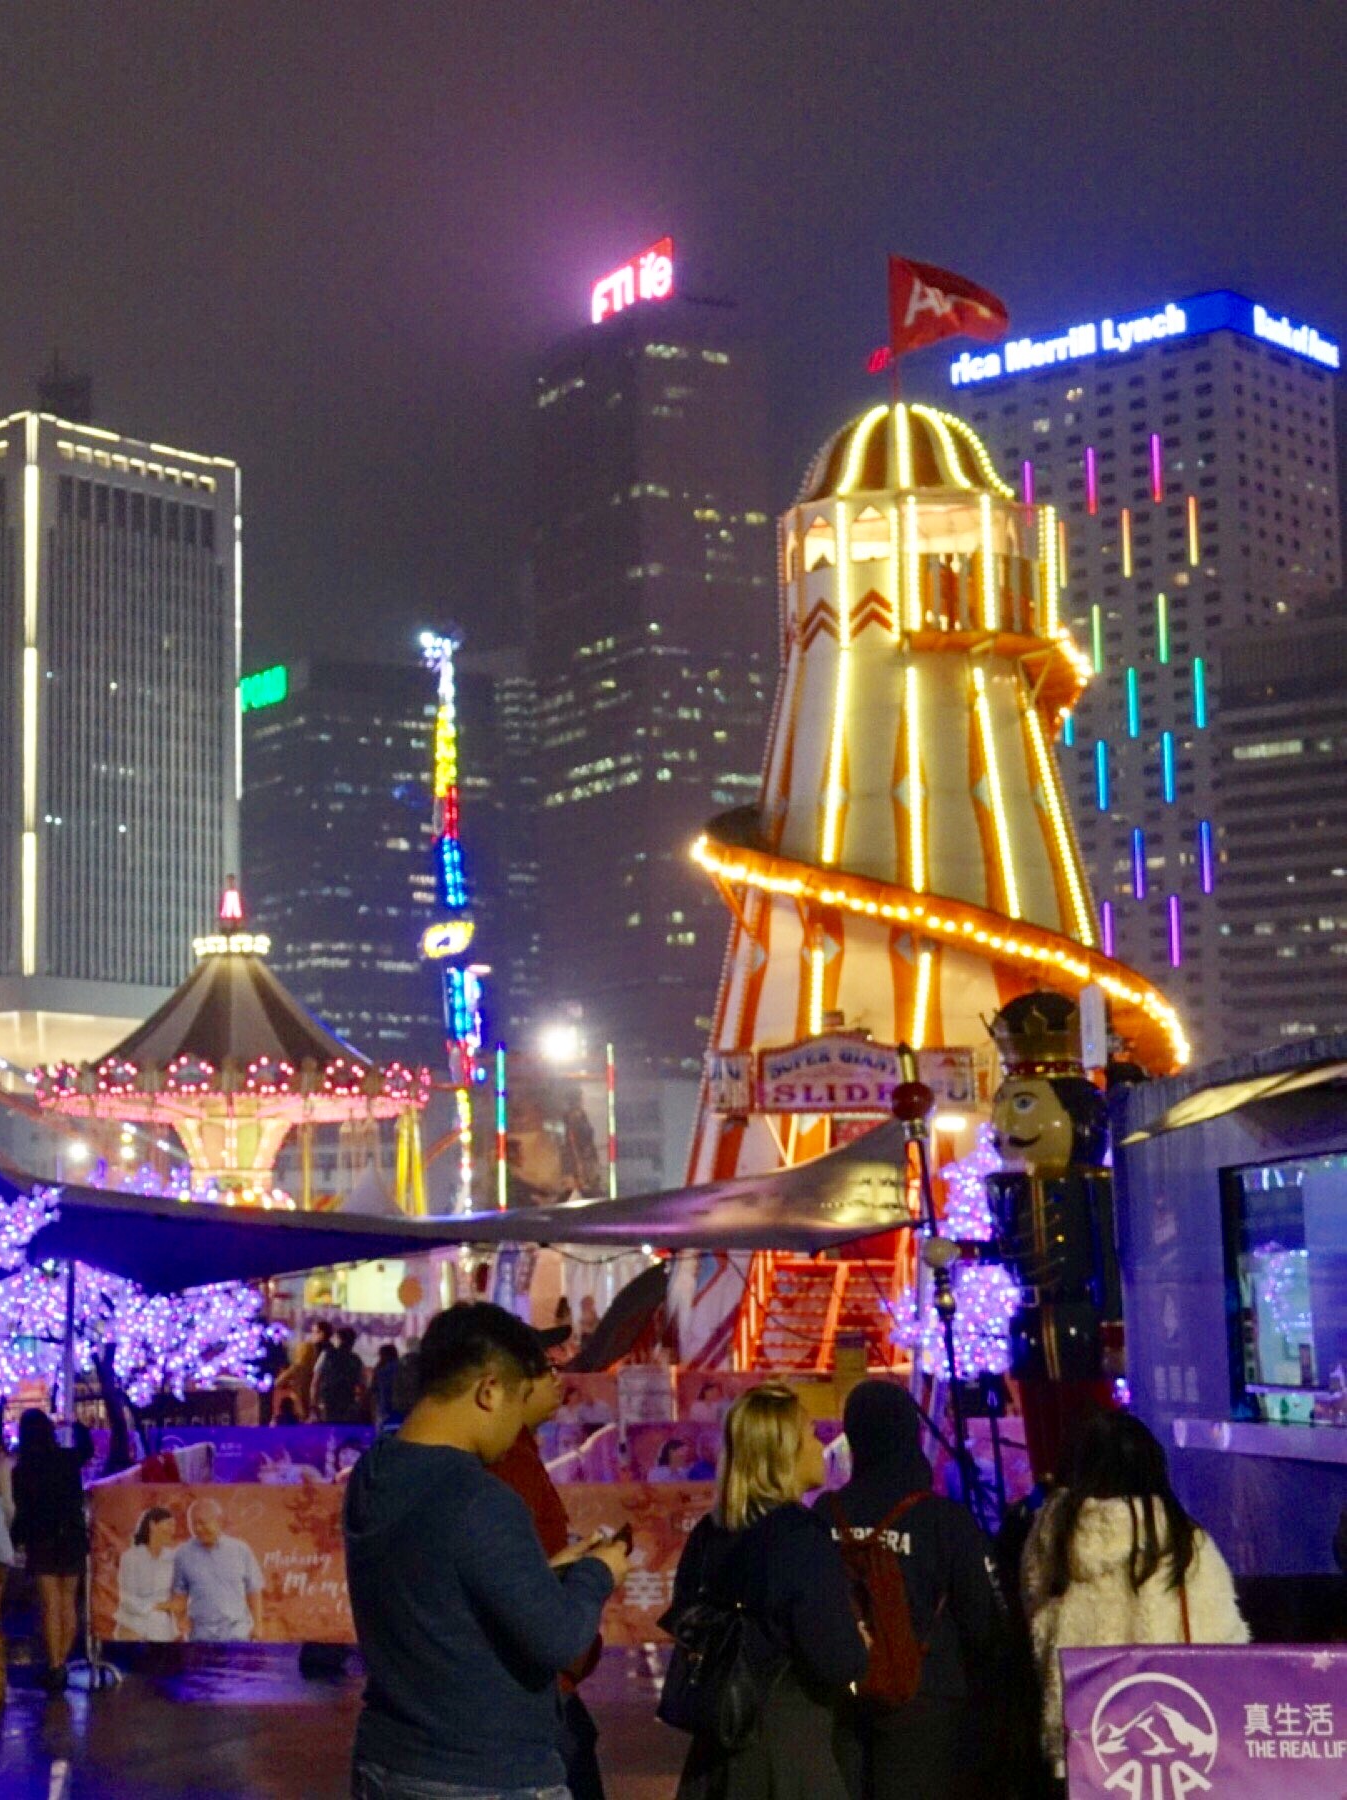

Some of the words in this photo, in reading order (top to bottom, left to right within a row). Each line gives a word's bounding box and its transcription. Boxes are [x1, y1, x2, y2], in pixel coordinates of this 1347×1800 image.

[1005, 323, 1097, 372] Merrill
[1101, 303, 1186, 352] Lynch
[1243, 1703, 1333, 1736] 真生活
[1245, 1740, 1277, 1758] THE
[1279, 1740, 1321, 1758] REAL
[1104, 1759, 1212, 1800] AIA
